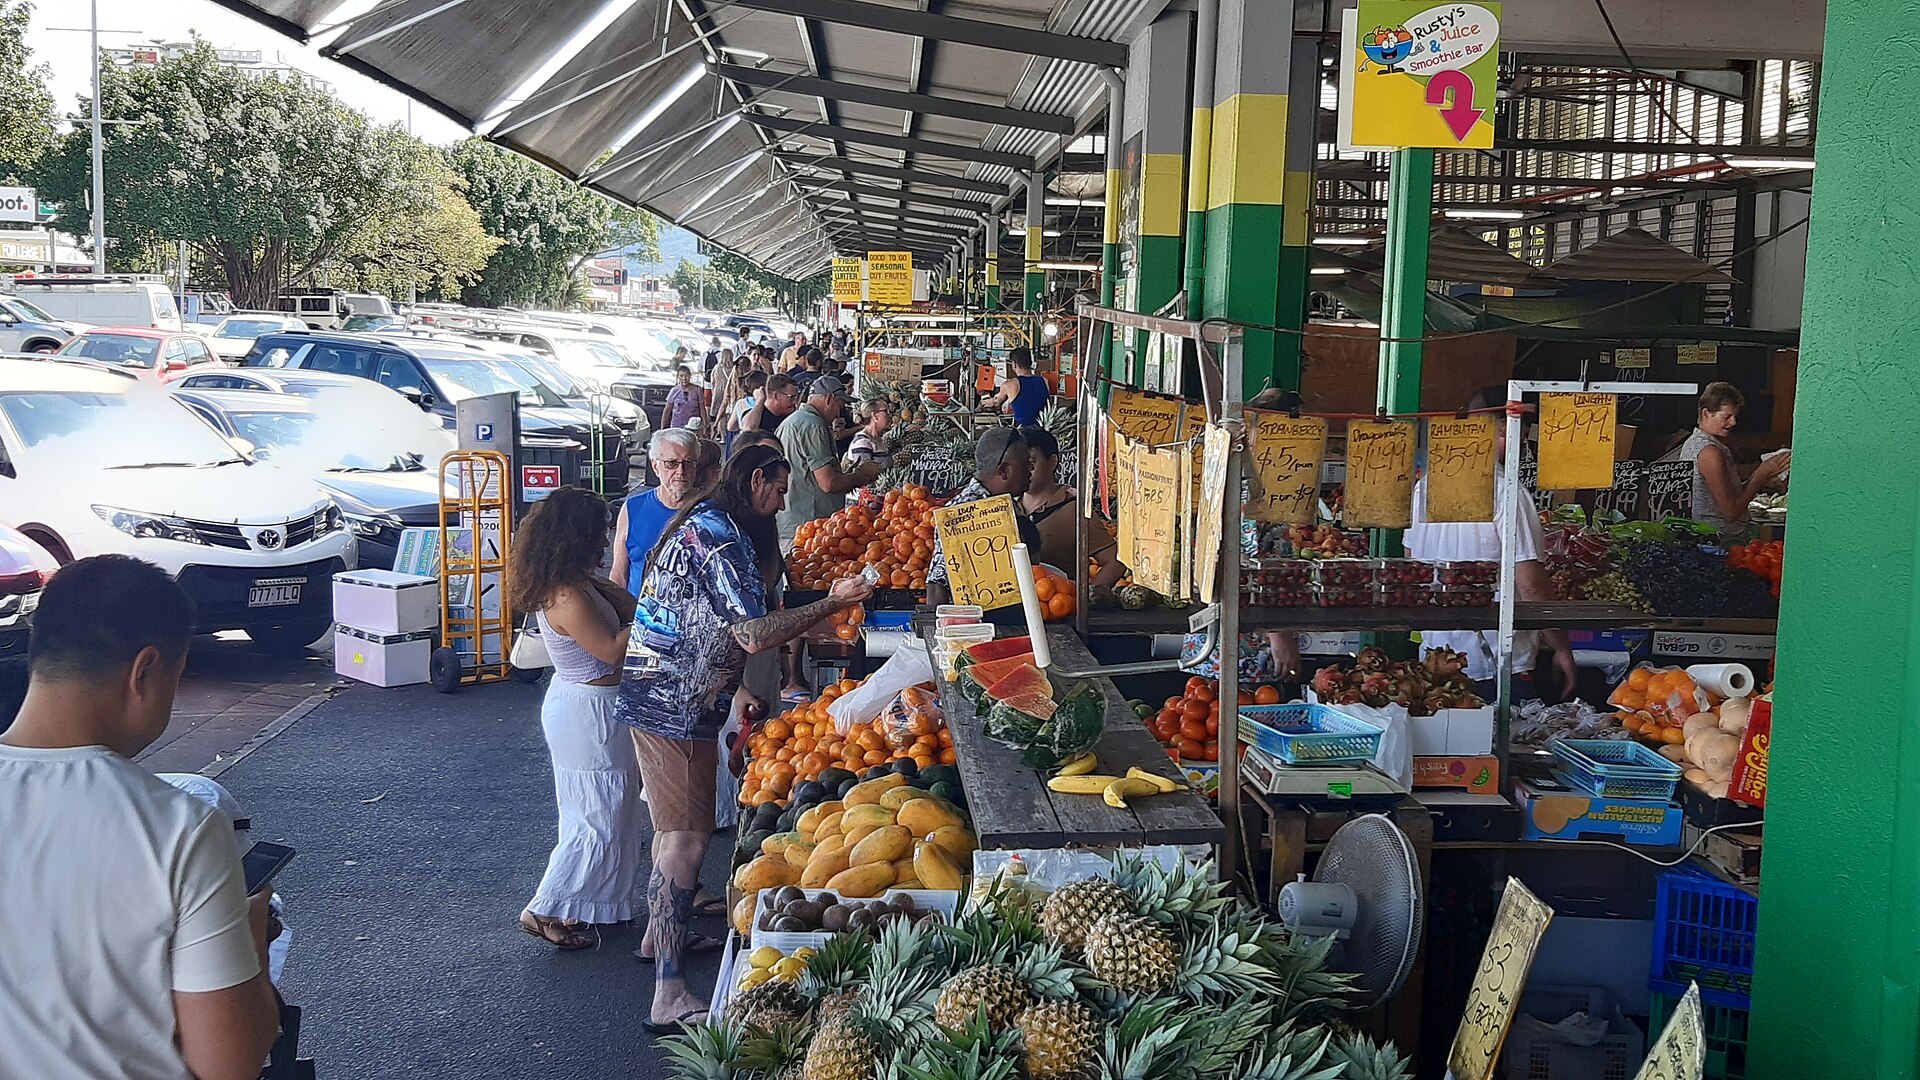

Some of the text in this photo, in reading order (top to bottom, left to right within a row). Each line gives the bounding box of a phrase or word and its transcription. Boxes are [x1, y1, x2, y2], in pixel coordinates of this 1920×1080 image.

[1414, 6, 1466, 40] Rusty's
[1440, 24, 1481, 42] Juice
[1429, 39, 1441, 53] &
[1409, 43, 1484, 72] Smoothie Bar
[838, 257, 859, 265] FRESH
[869, 254, 885, 262] GOOD
[898, 254, 907, 262] GO
[871, 263, 907, 271] SEASONAL
[835, 281, 860, 289] GRATED
[1574, 393, 1612, 405] LONGAN
[1431, 422, 1487, 437] RAMBUTAN
[957, 504, 979, 516] LOCAL
[944, 518, 1003, 538] Mandarins
[1657, 643, 1699, 653] GLOBAL
[1605, 805, 1665, 816] MANGOES
[1589, 812, 1665, 824] AUSTRALIAN
